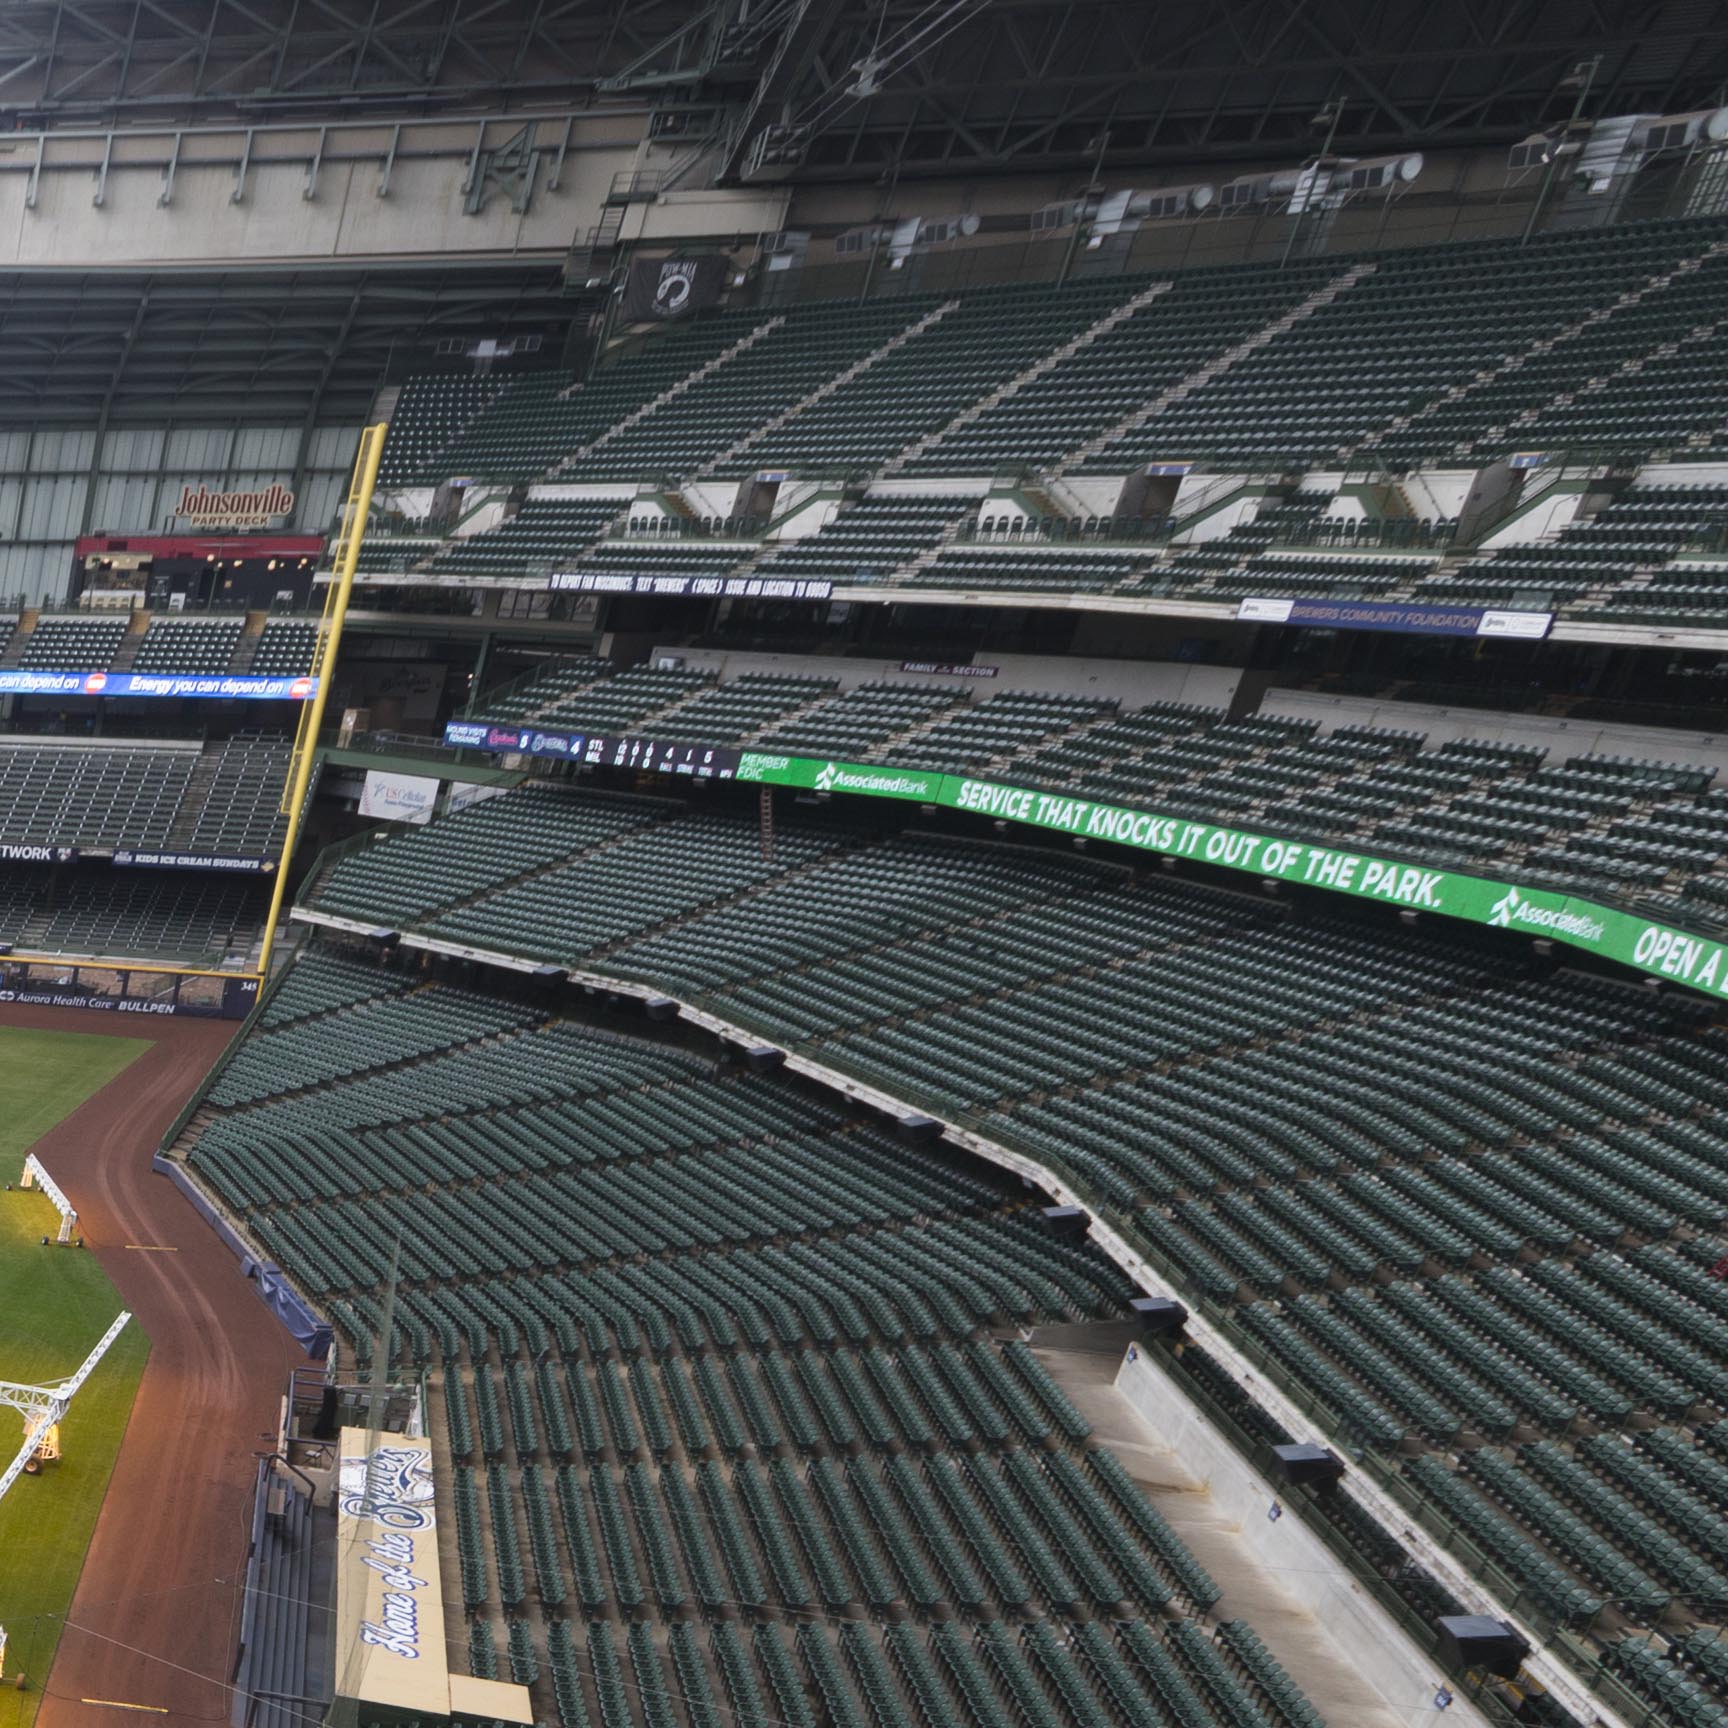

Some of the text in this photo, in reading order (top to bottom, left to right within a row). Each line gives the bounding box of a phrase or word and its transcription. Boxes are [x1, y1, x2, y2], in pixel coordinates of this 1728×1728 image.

[176, 484, 294, 517] Johnsonville
[192, 514, 270, 526] PARTY DECK
[1405, 612, 1480, 629] FOUNDATION
[953, 666, 994, 677] SECTION
[129, 677, 173, 695] Energy
[743, 753, 790, 771] MEMBER
[956, 780, 1443, 908] SERVICE THAT KNOCKS OUT OF THE PARK.
[135, 854, 157, 864] KIDS
[1632, 927, 1704, 979] OPEN
[16, 992, 175, 1015] Aurora Health BULLPEN
[364, 1532, 415, 1564] the
[361, 1556, 428, 1588] of
[361, 1592, 420, 1659] Home
